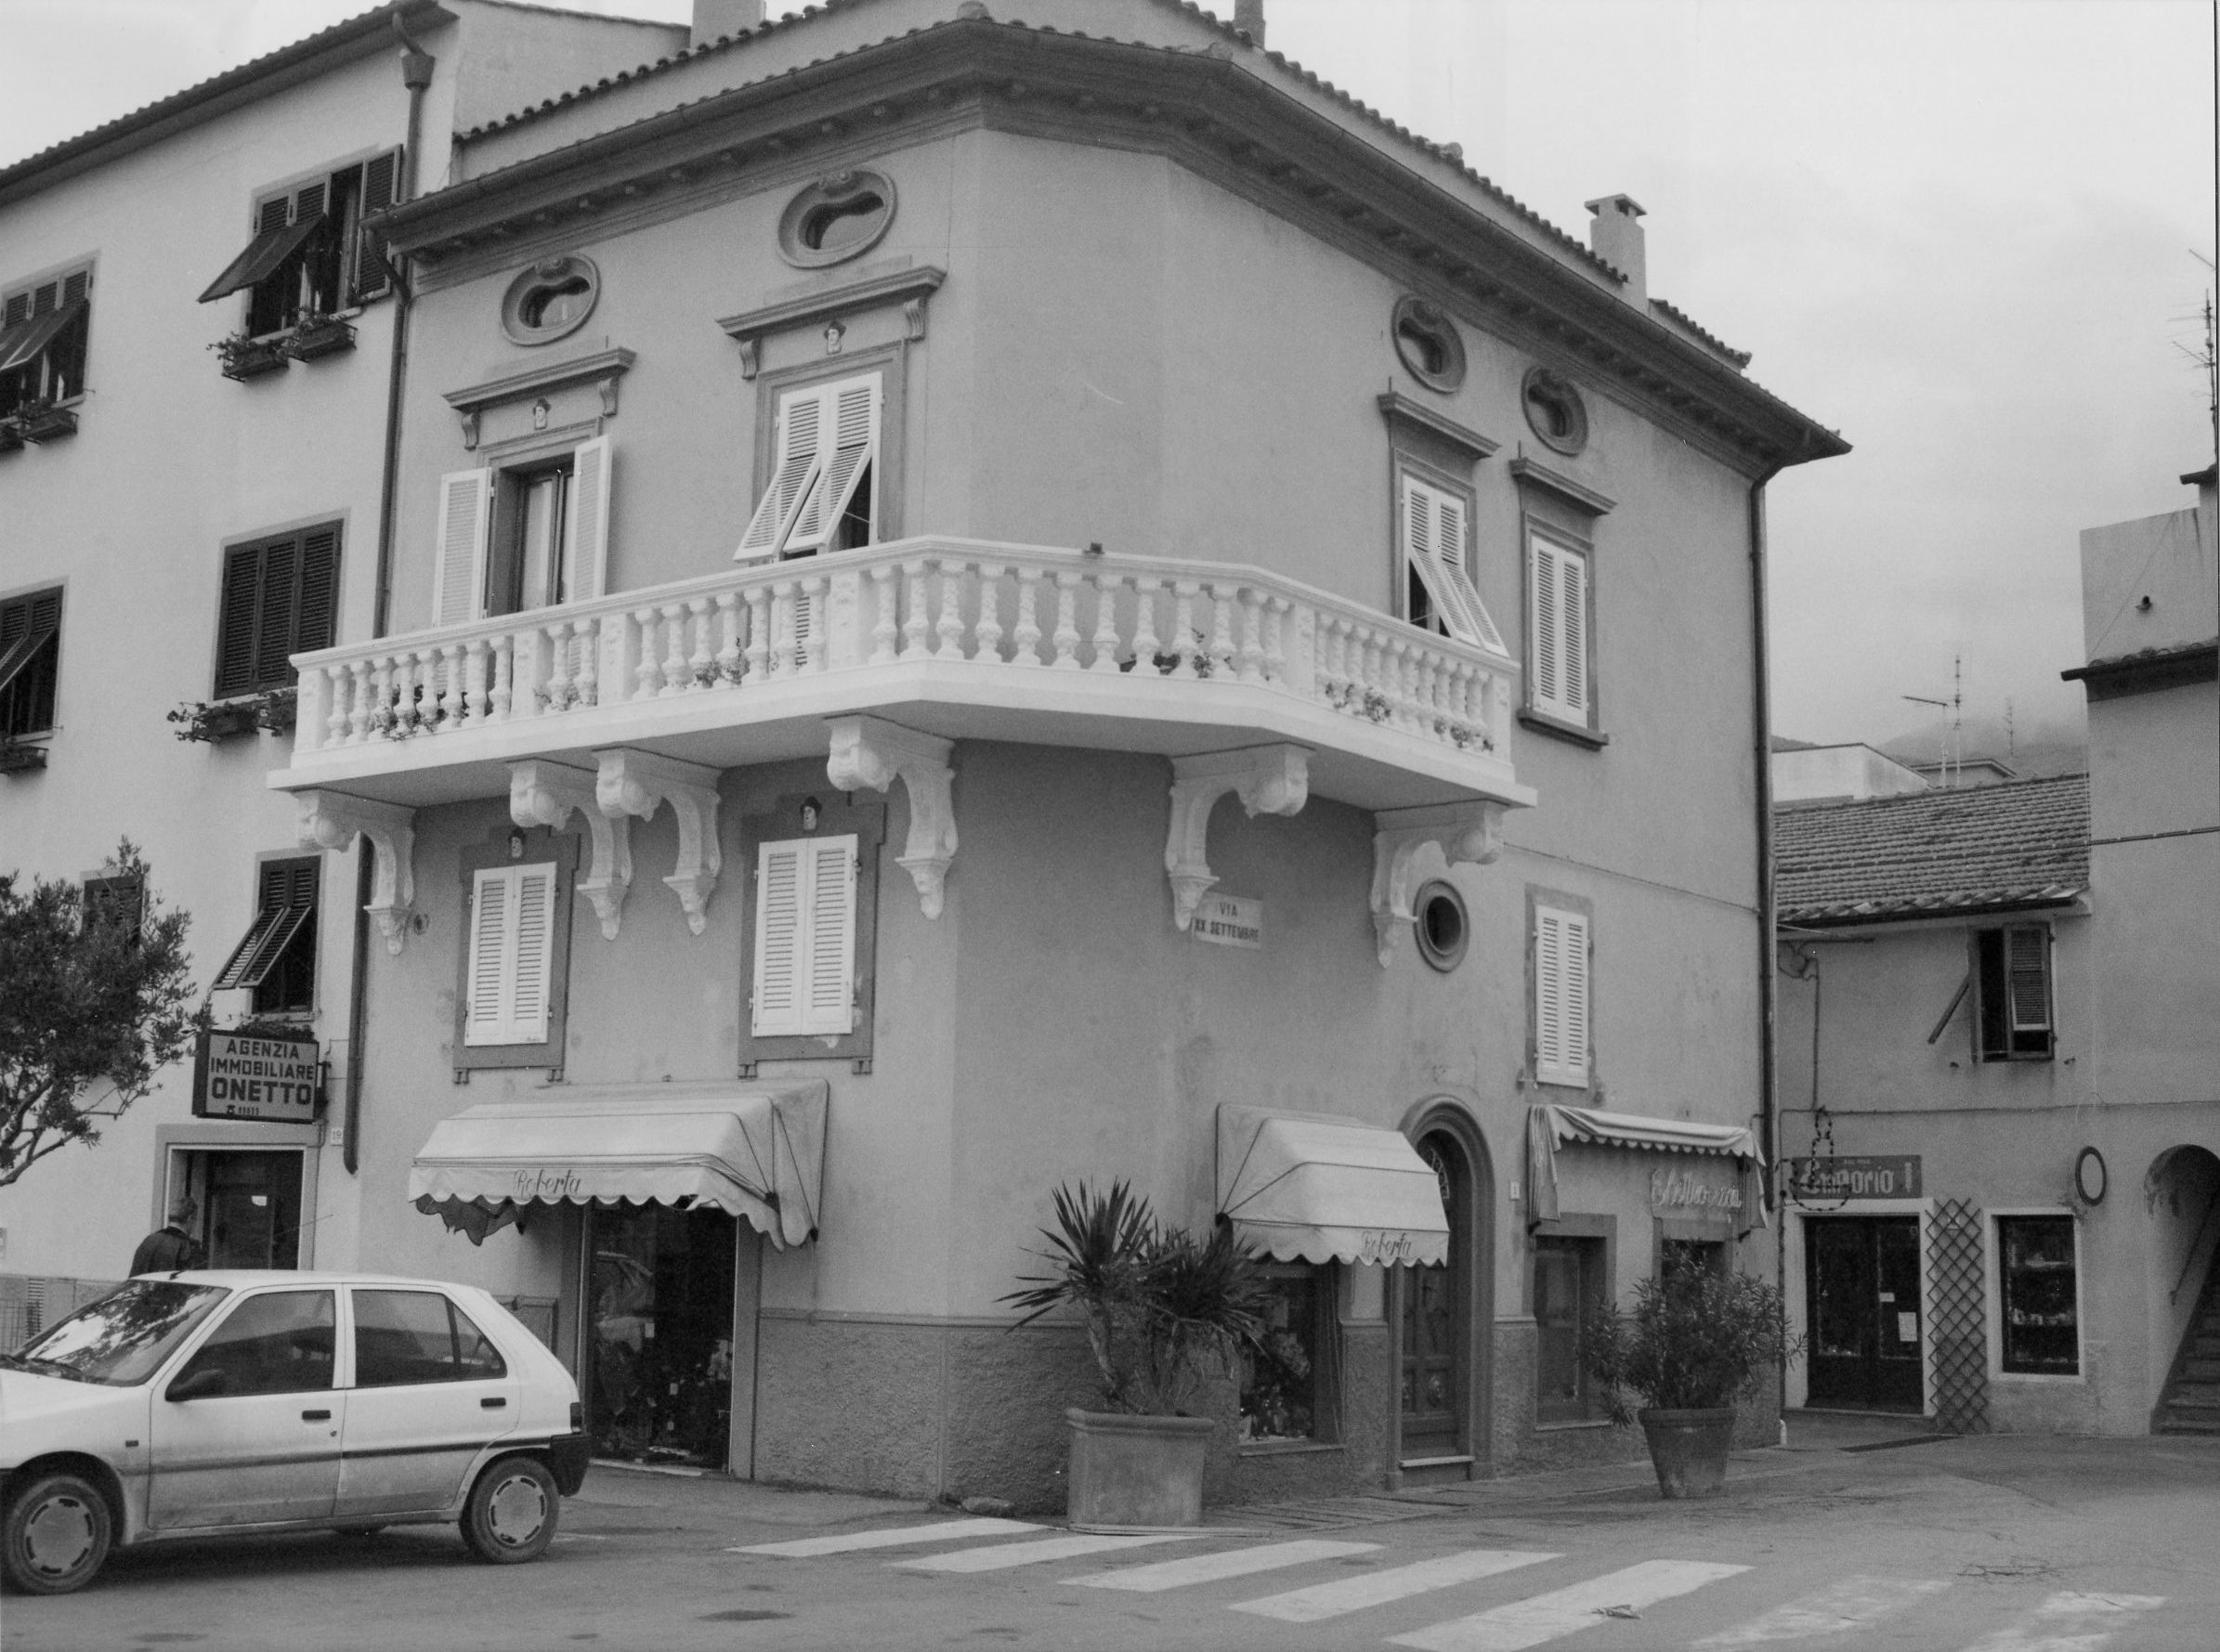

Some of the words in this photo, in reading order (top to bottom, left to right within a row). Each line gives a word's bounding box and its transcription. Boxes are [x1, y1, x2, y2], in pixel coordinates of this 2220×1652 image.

[1219, 902, 1237, 917] VIA
[1209, 920, 1260, 943] SETTEMBRE
[226, 1038, 300, 1060] AGENZIA
[210, 1057, 314, 1081] IMMOBILIARE
[211, 1076, 312, 1105] ONETTO
[514, 1168, 581, 1199] Roberta
[1361, 1230, 1412, 1257] Roberta
